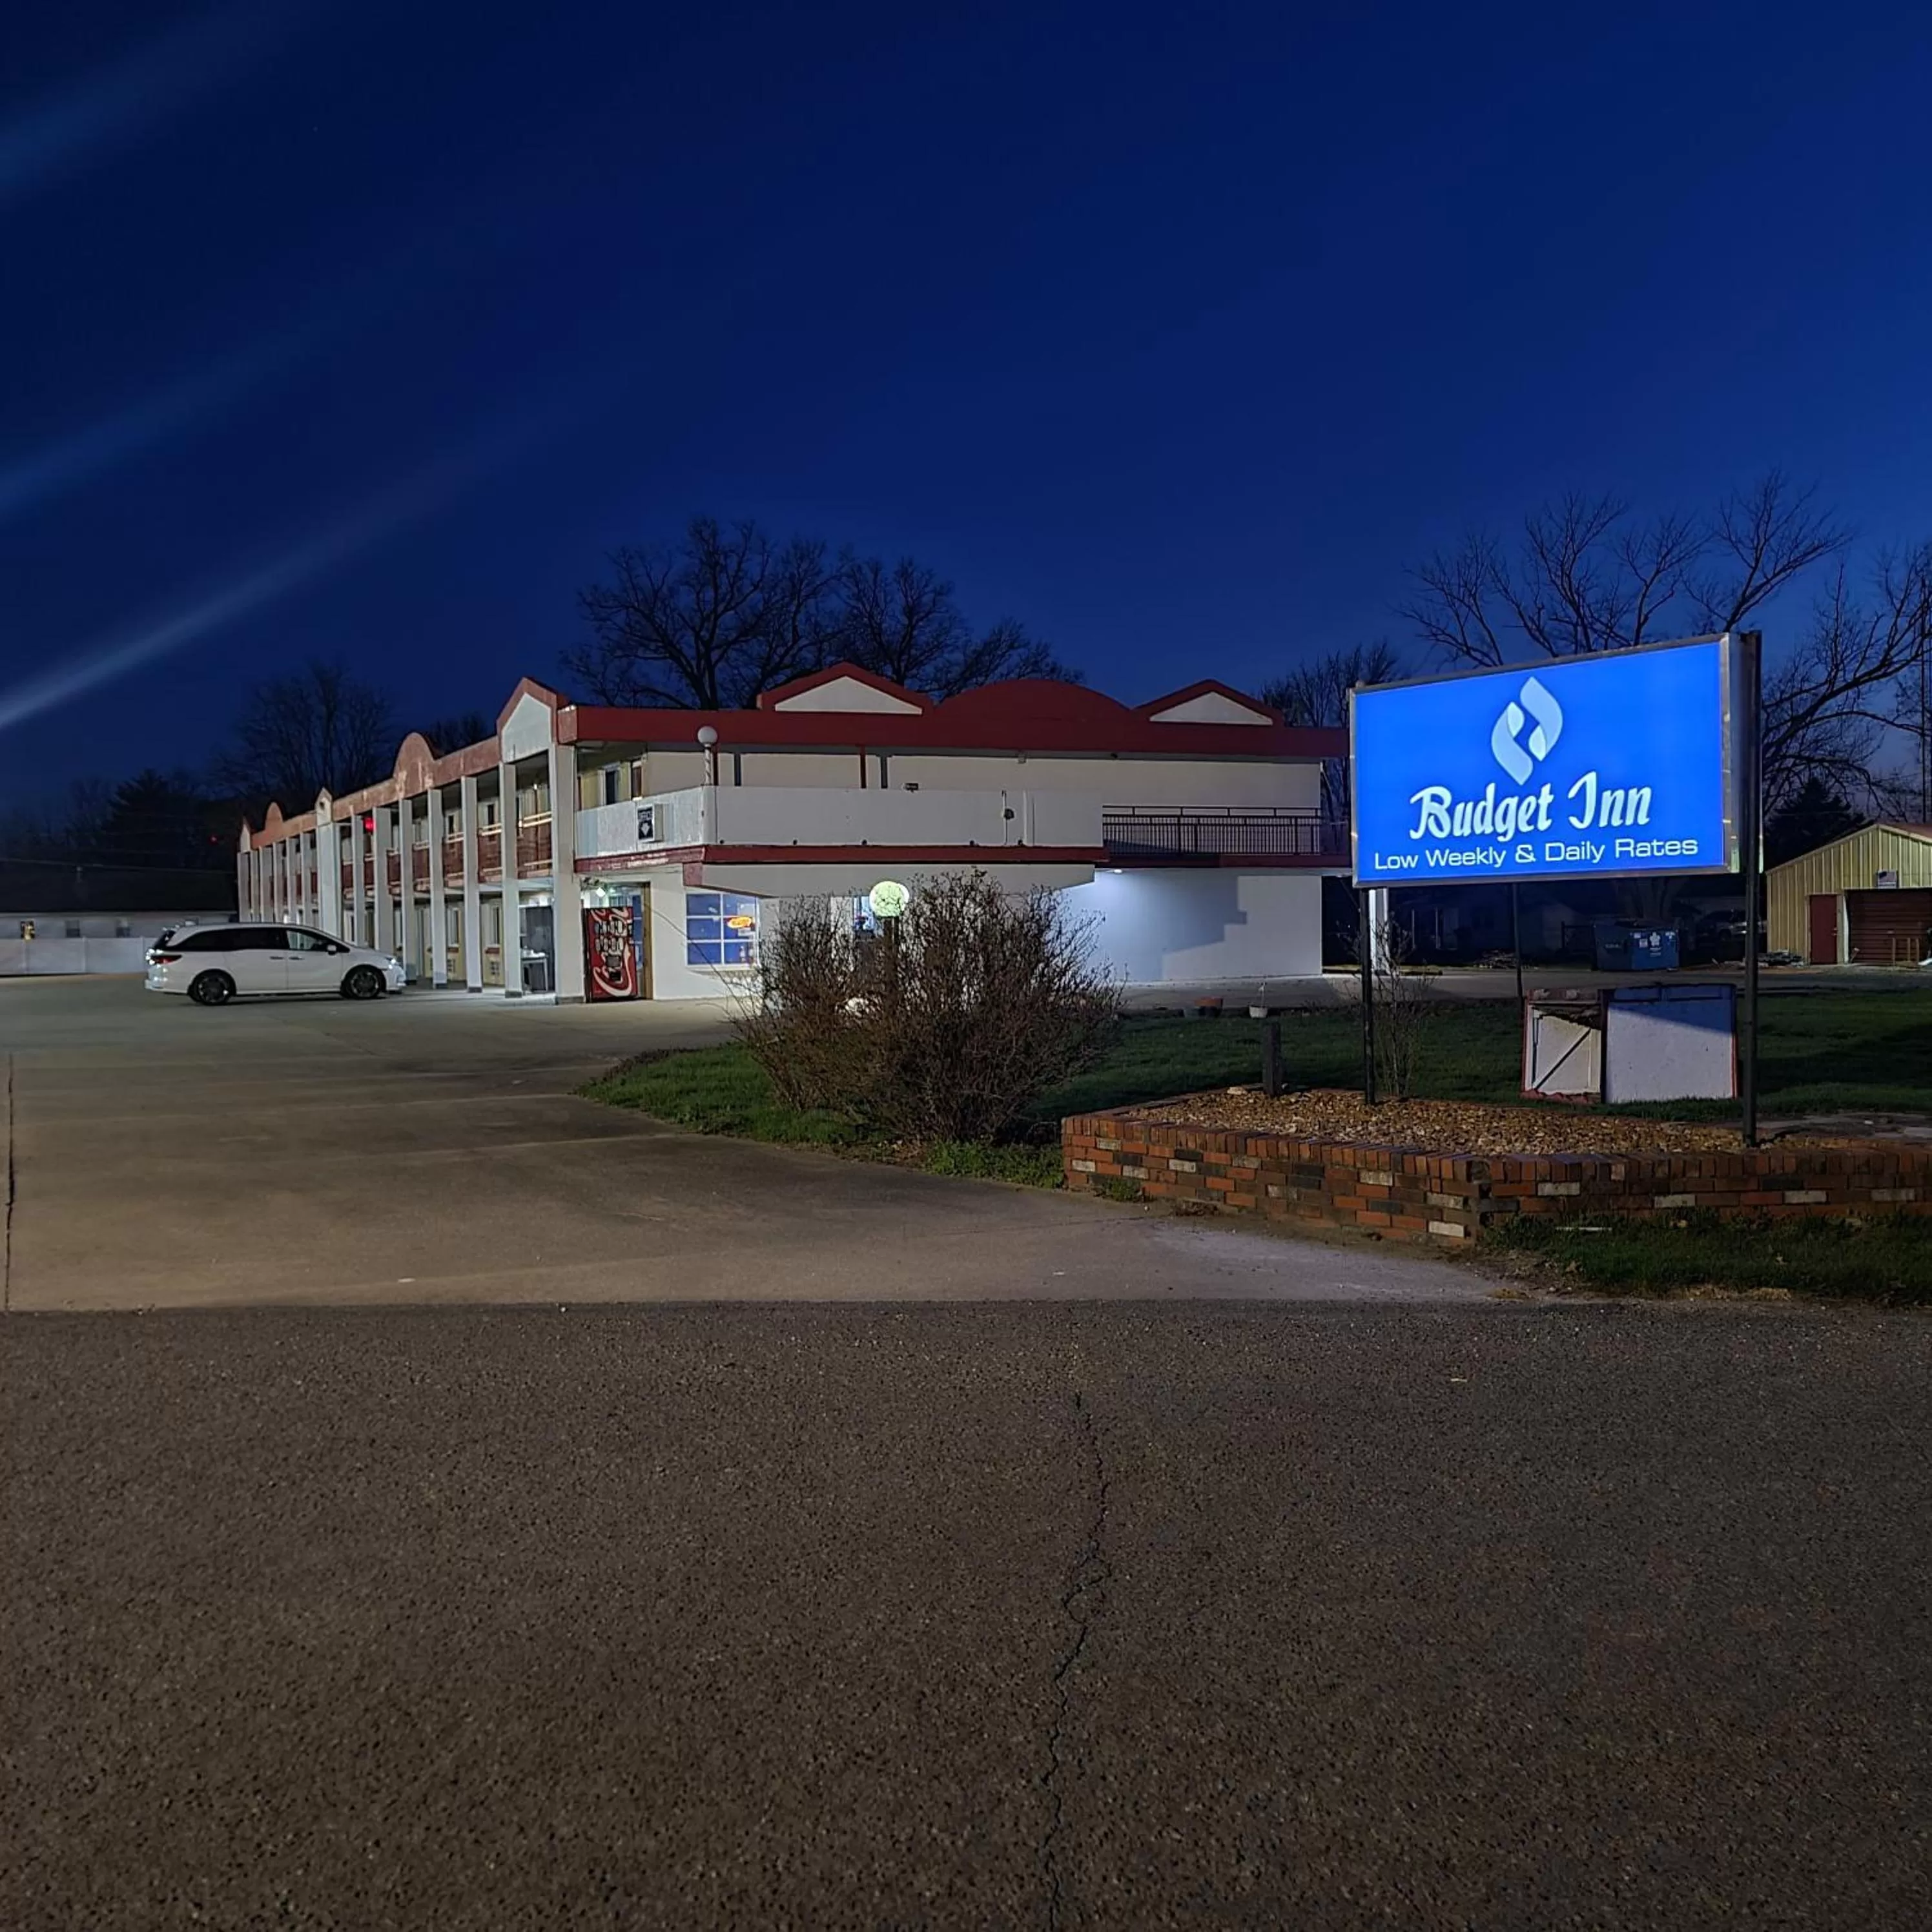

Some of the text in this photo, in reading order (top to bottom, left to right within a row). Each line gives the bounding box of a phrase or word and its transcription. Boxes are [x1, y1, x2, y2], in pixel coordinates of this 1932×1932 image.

[1410, 771, 1652, 842] Budget Inn
[1375, 838, 1698, 870] Low Weekly & Daily Rates
